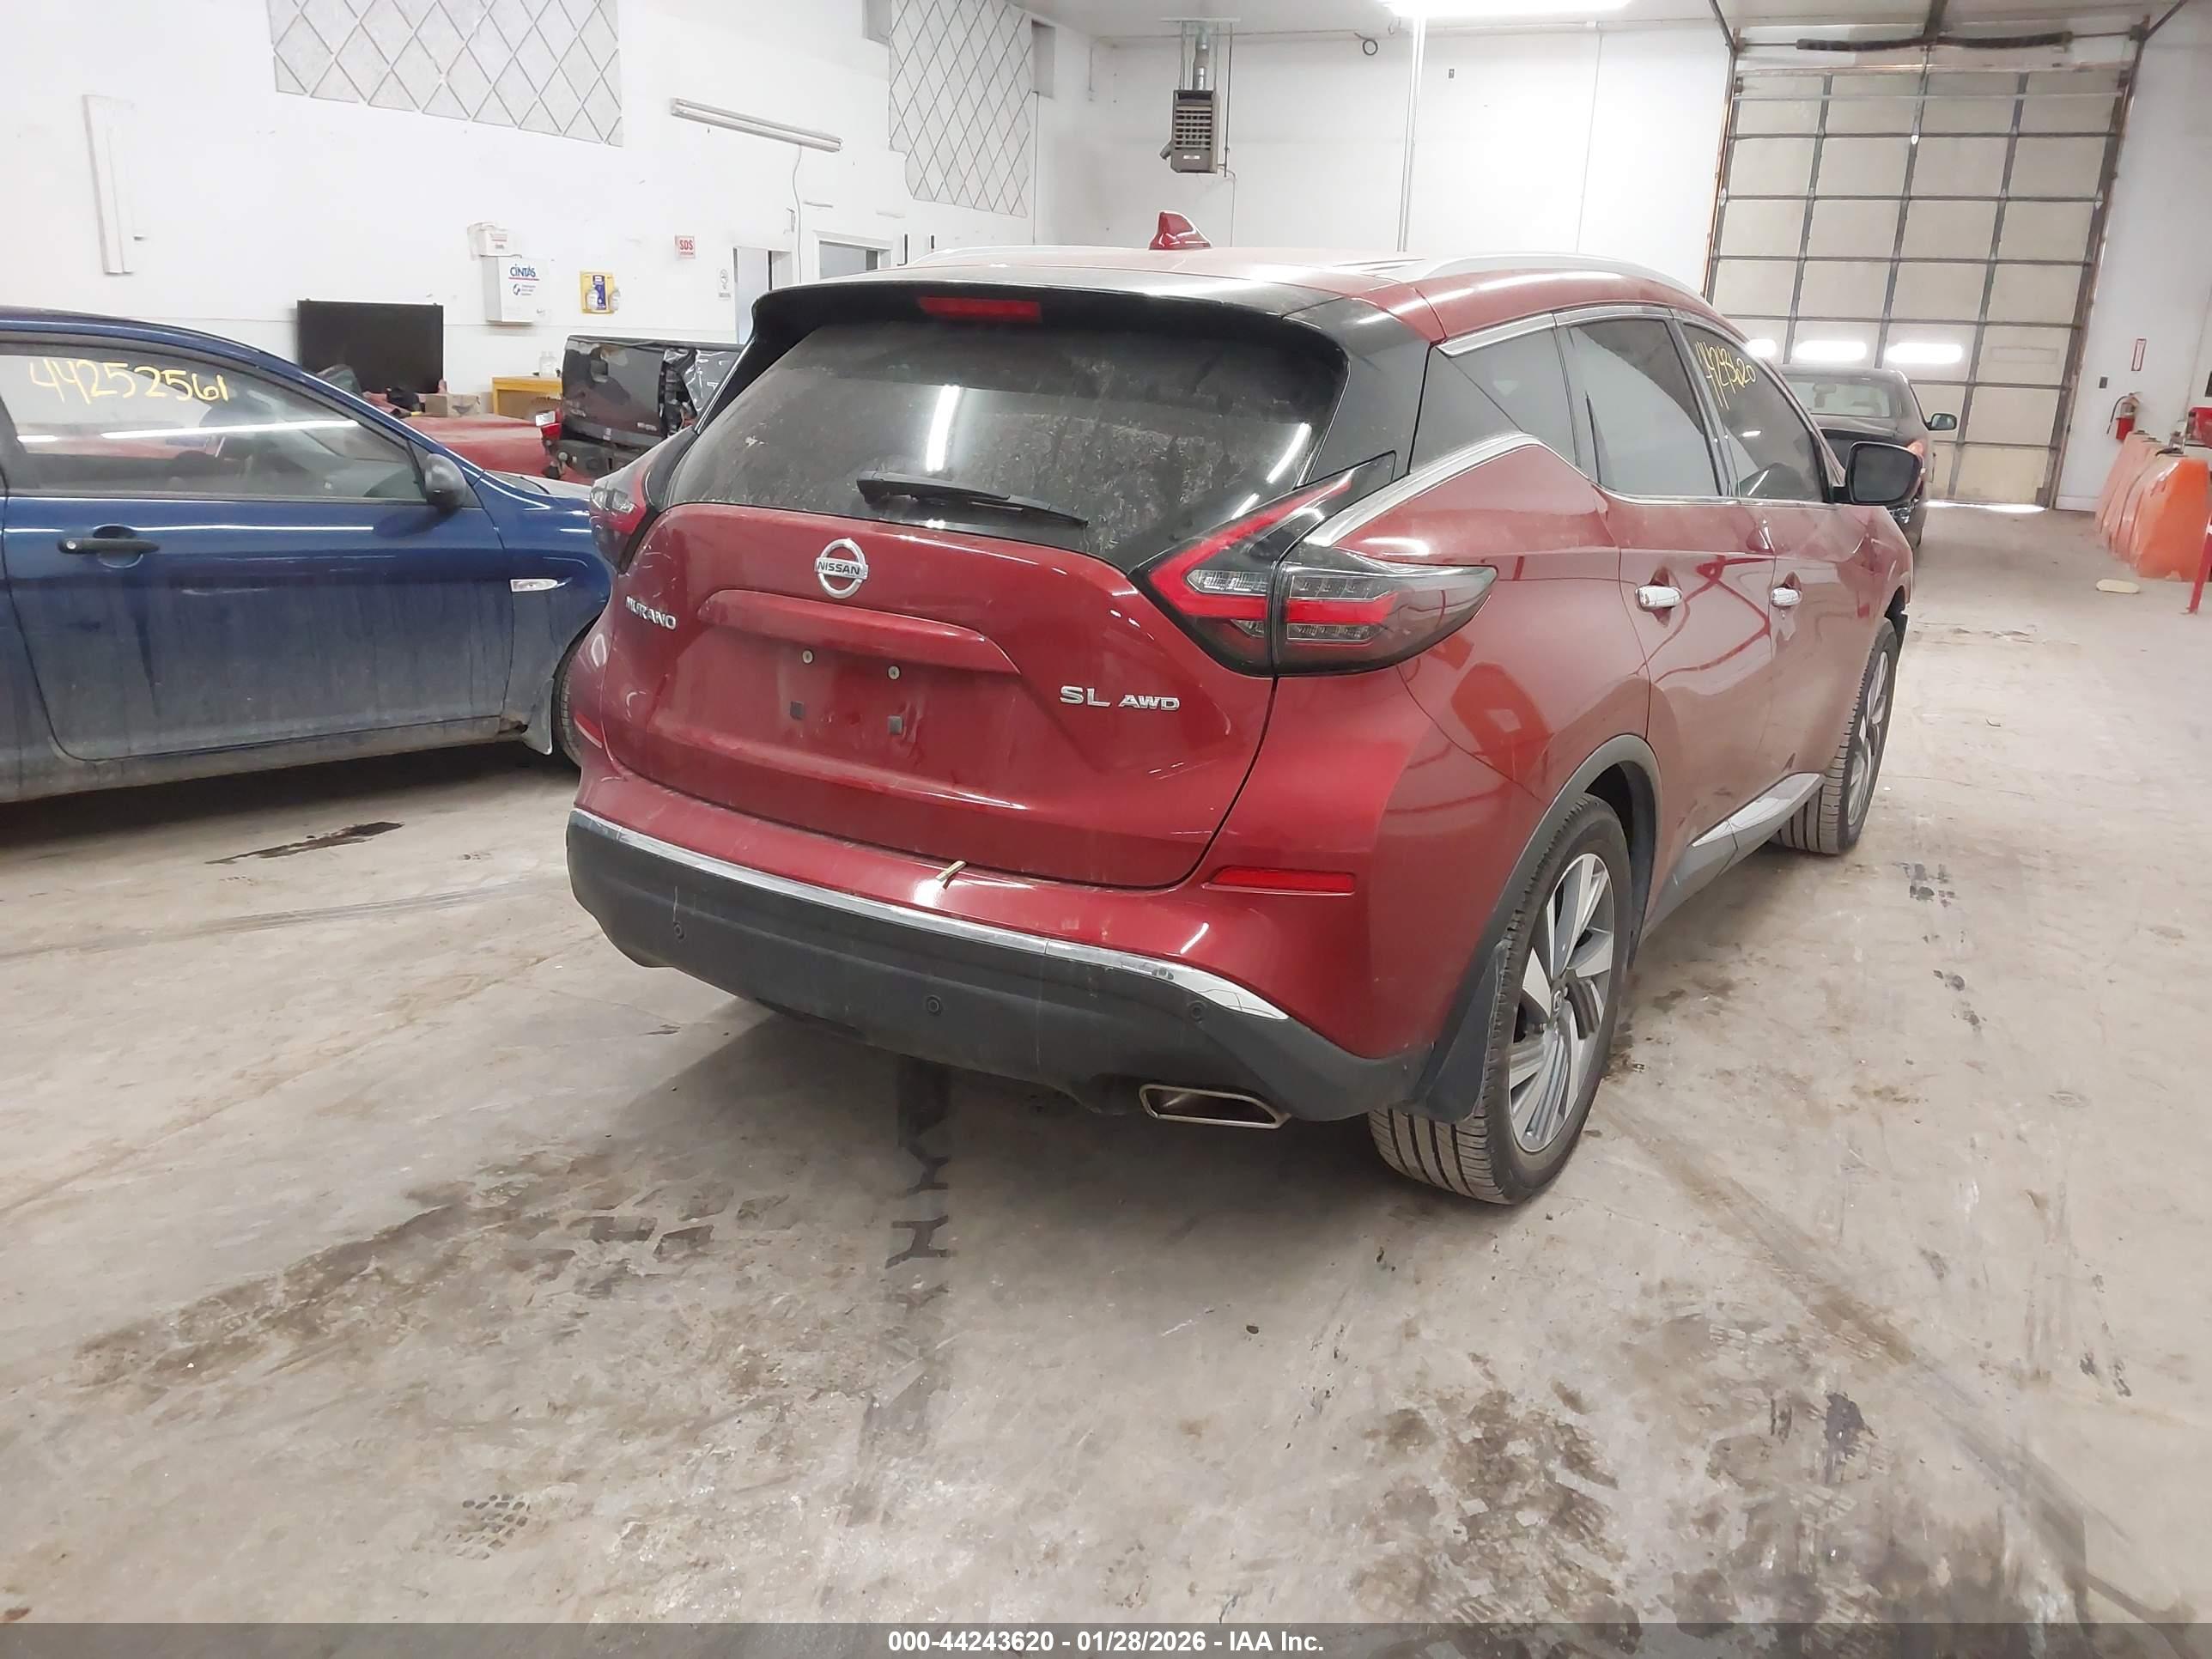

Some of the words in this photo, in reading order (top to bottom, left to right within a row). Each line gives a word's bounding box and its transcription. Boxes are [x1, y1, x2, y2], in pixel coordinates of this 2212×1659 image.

[28, 357, 230, 405] 44252561
[817, 561, 860, 575] NISSAN
[625, 595, 678, 631] MURANO
[1059, 685, 1112, 708] SL
[1118, 694, 1181, 711] AWD
